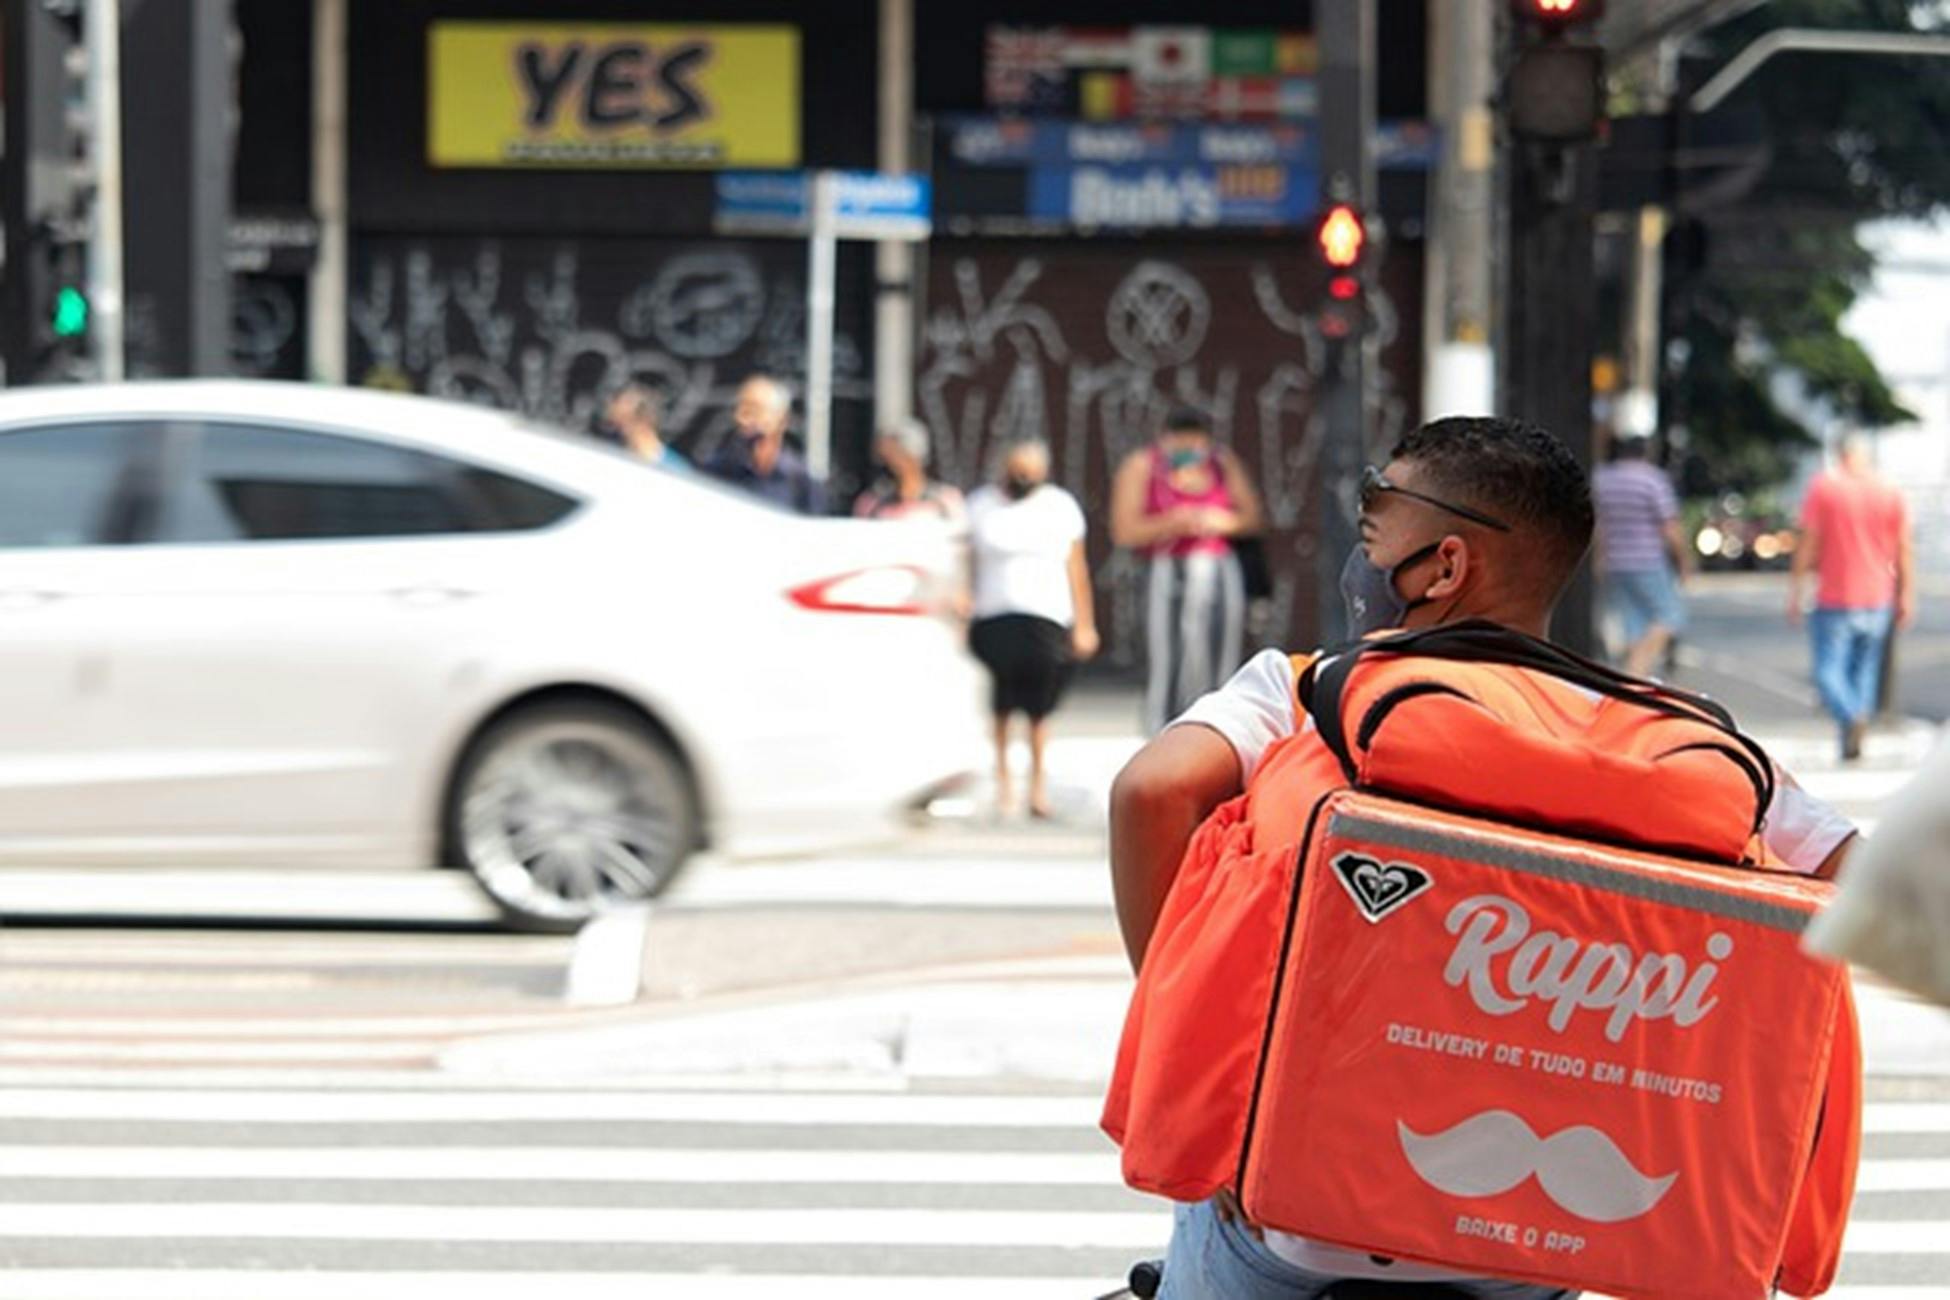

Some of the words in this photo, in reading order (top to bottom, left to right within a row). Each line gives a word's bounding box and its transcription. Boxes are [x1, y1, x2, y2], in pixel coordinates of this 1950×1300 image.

[517, 40, 714, 129] YES
[1444, 894, 1734, 1043] Rappi
[1386, 1023, 1489, 1059] DELIVERY
[1494, 1044, 1524, 1067] DE
[1530, 1050, 1586, 1078] TUDO
[1592, 1062, 1626, 1085] EM
[1630, 1069, 1722, 1104] MINUTOS
[1456, 1215, 1518, 1244] BAIXE
[1523, 1226, 1538, 1248] O
[1544, 1230, 1586, 1255] APP
